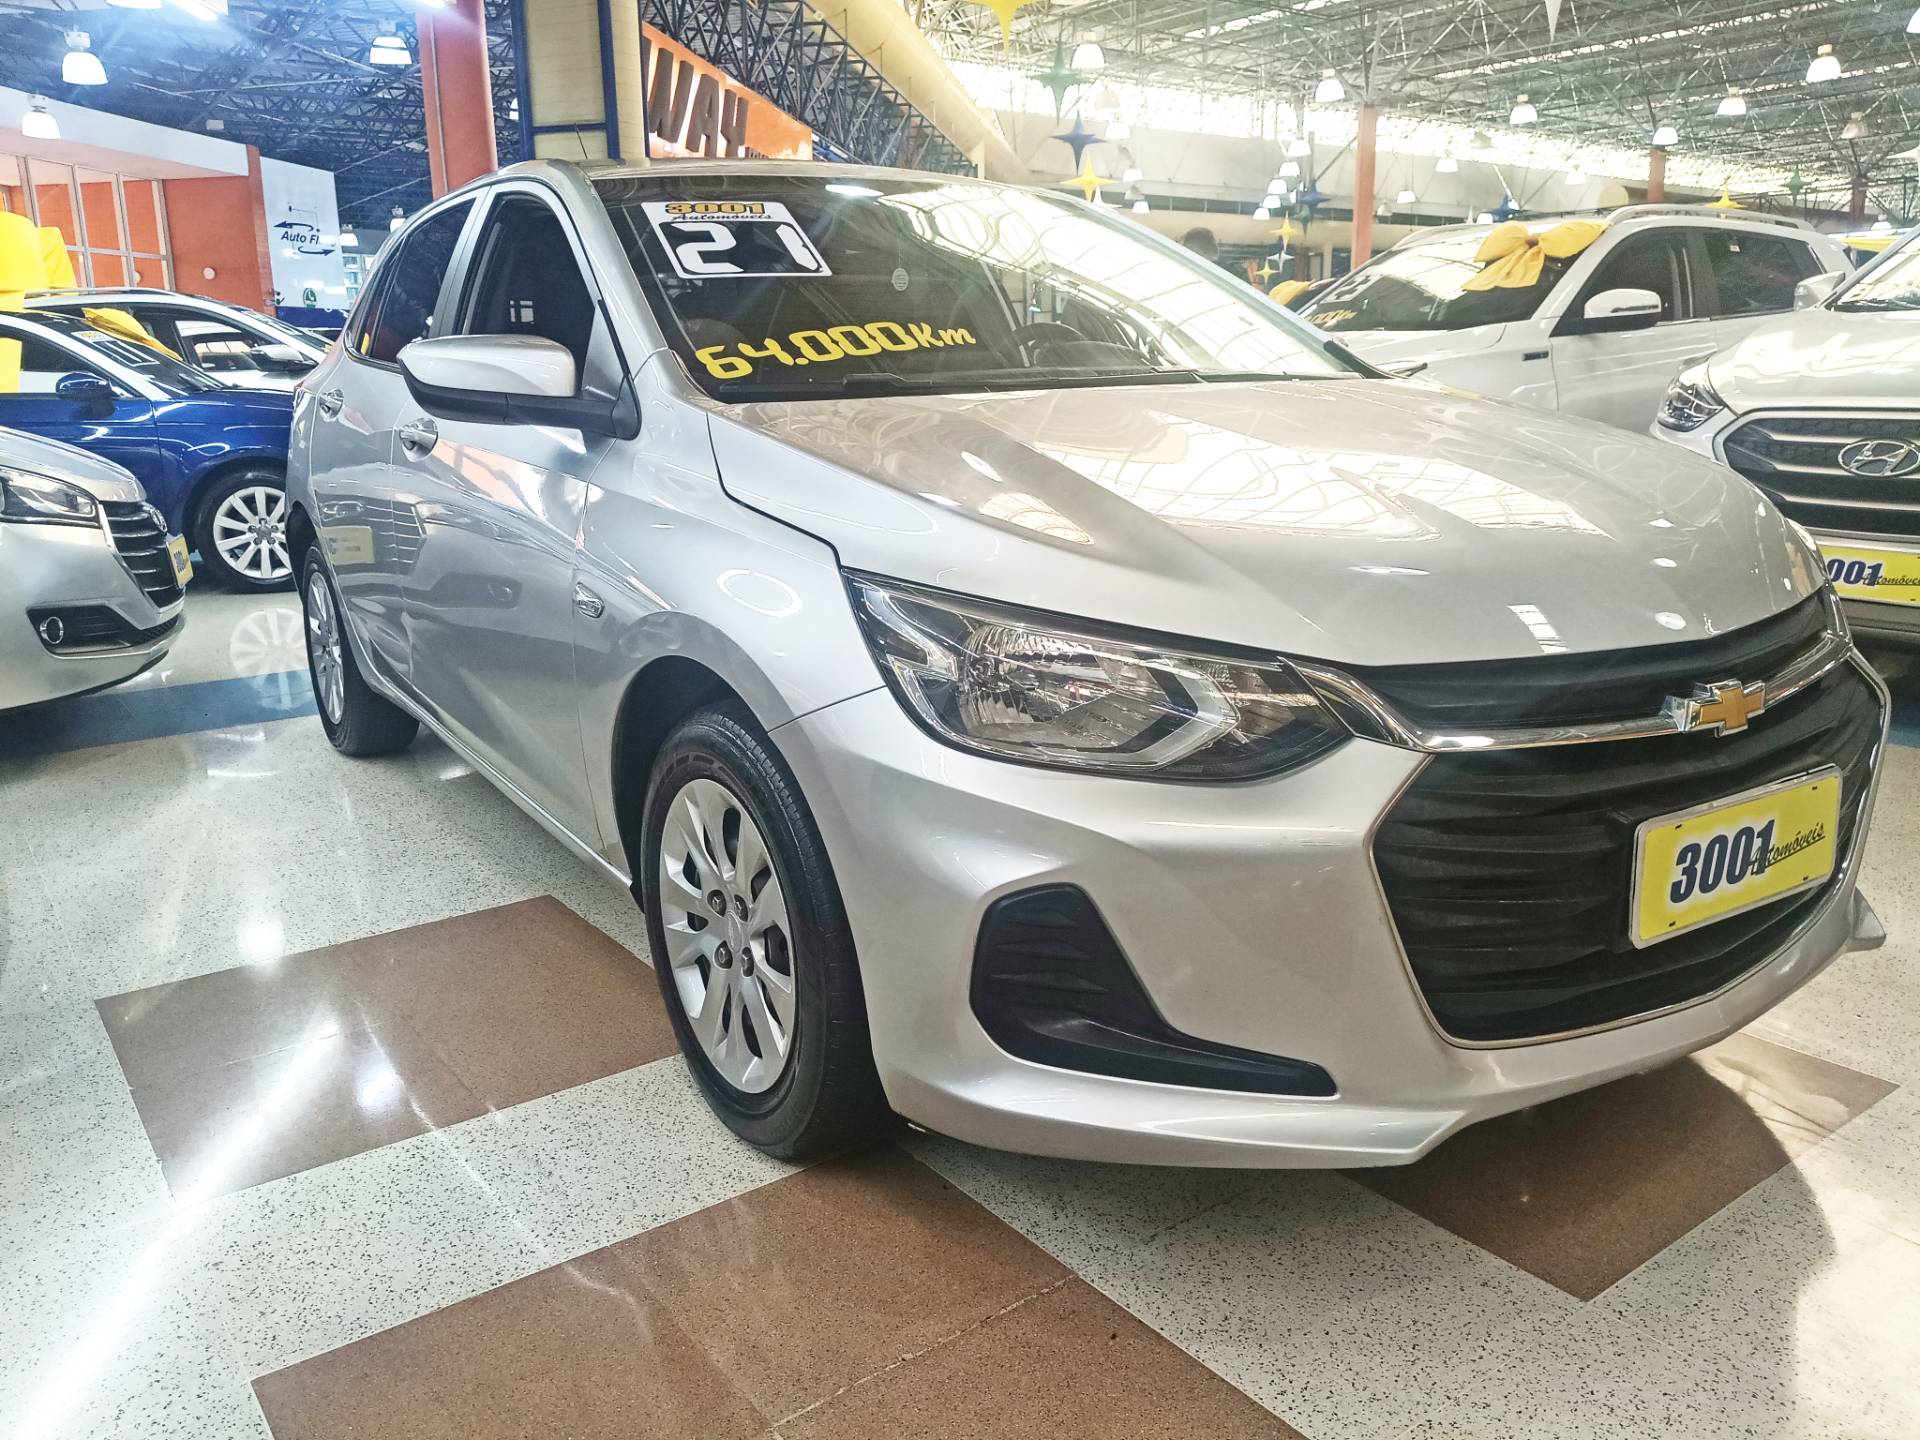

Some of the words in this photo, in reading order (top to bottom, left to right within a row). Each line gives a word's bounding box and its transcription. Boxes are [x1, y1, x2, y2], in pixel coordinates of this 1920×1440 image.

[665, 203, 765, 214] 3001
[281, 231, 306, 244] Auto
[671, 222, 818, 274] 21
[1827, 559, 1883, 587] 001
[1670, 819, 1775, 904] 3001
